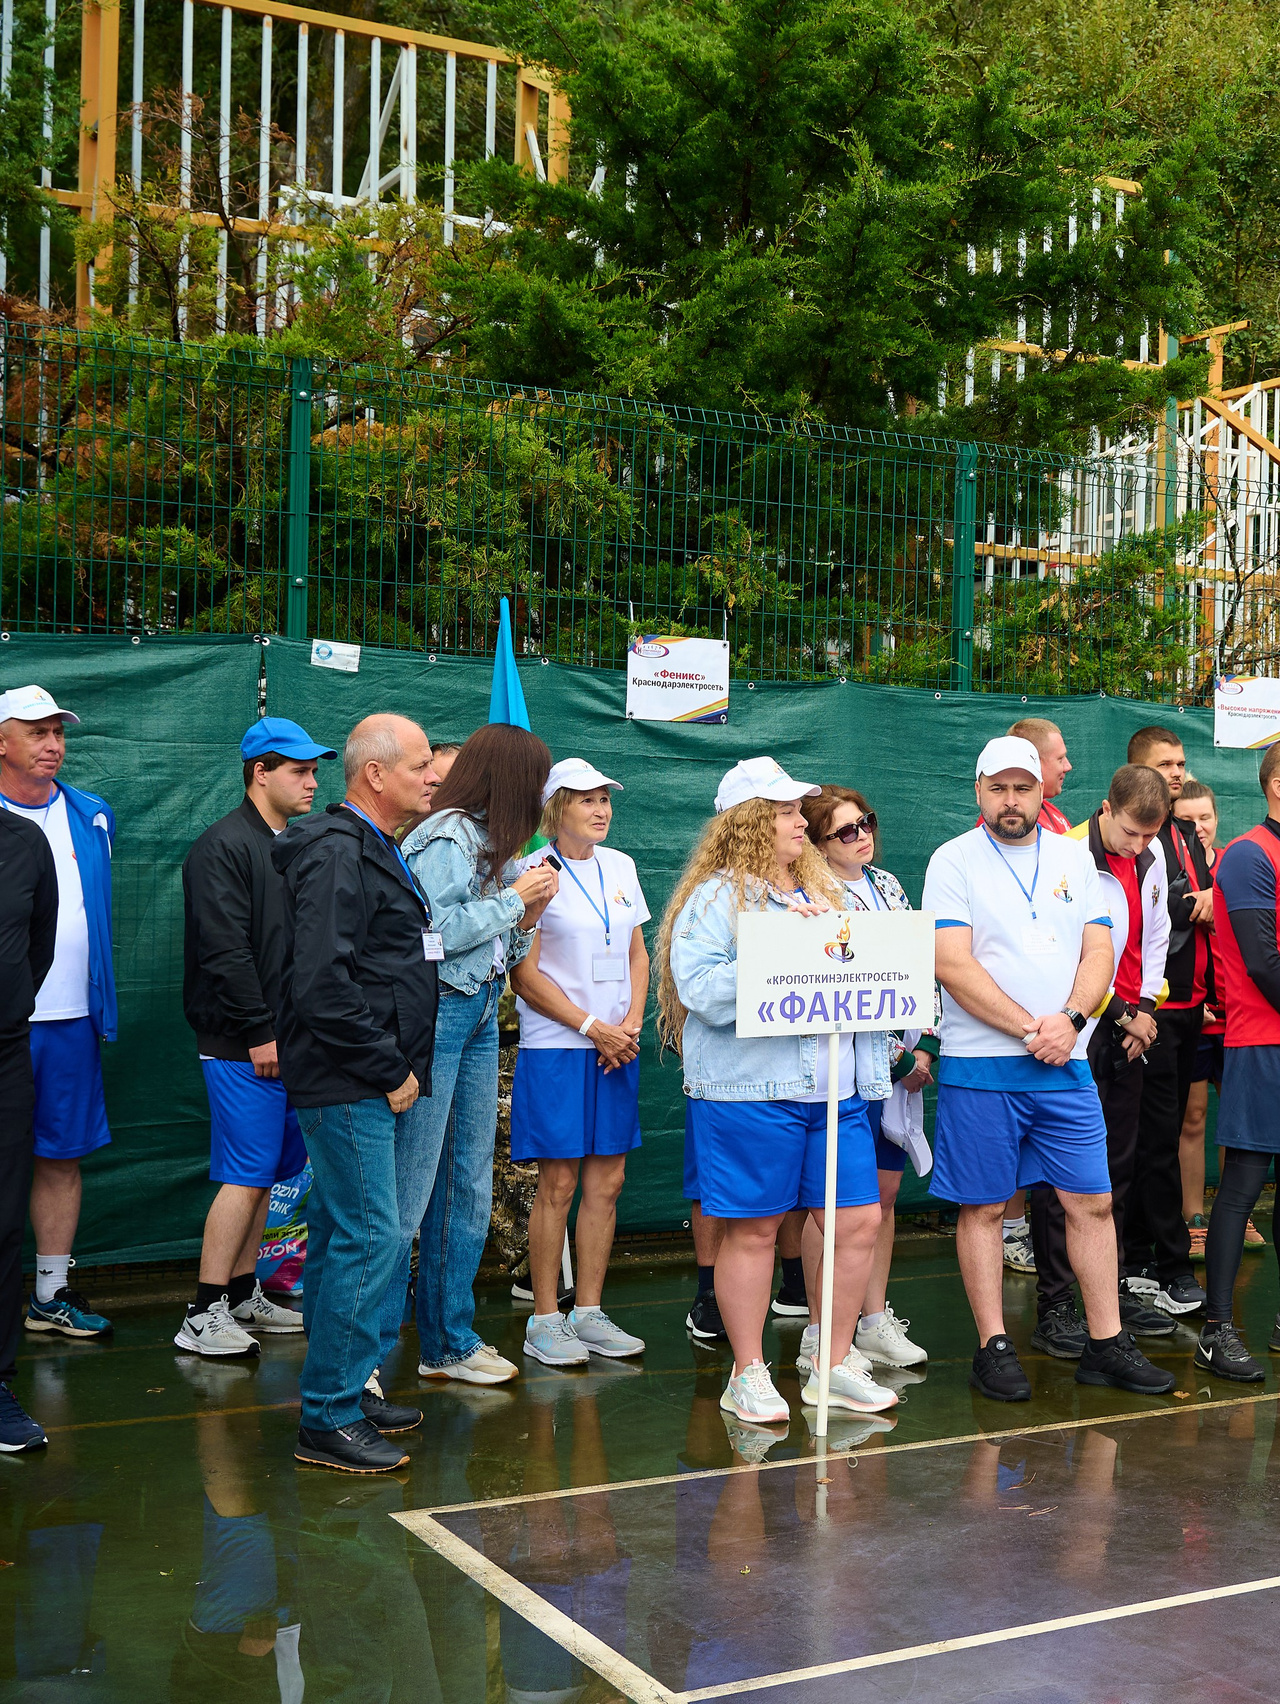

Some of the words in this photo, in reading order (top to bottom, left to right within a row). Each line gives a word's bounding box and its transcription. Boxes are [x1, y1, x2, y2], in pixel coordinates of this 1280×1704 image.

[653, 669, 706, 681] «Феникс»
[632, 677, 724, 691] Краснодарэлектросеть
[766, 971, 910, 985] «КРОПОТКИНЭЛЕКТРОСЕТЬ»
[757, 989, 917, 1023] «ФАКЕЛ»
[268, 1199, 291, 1215] анк
